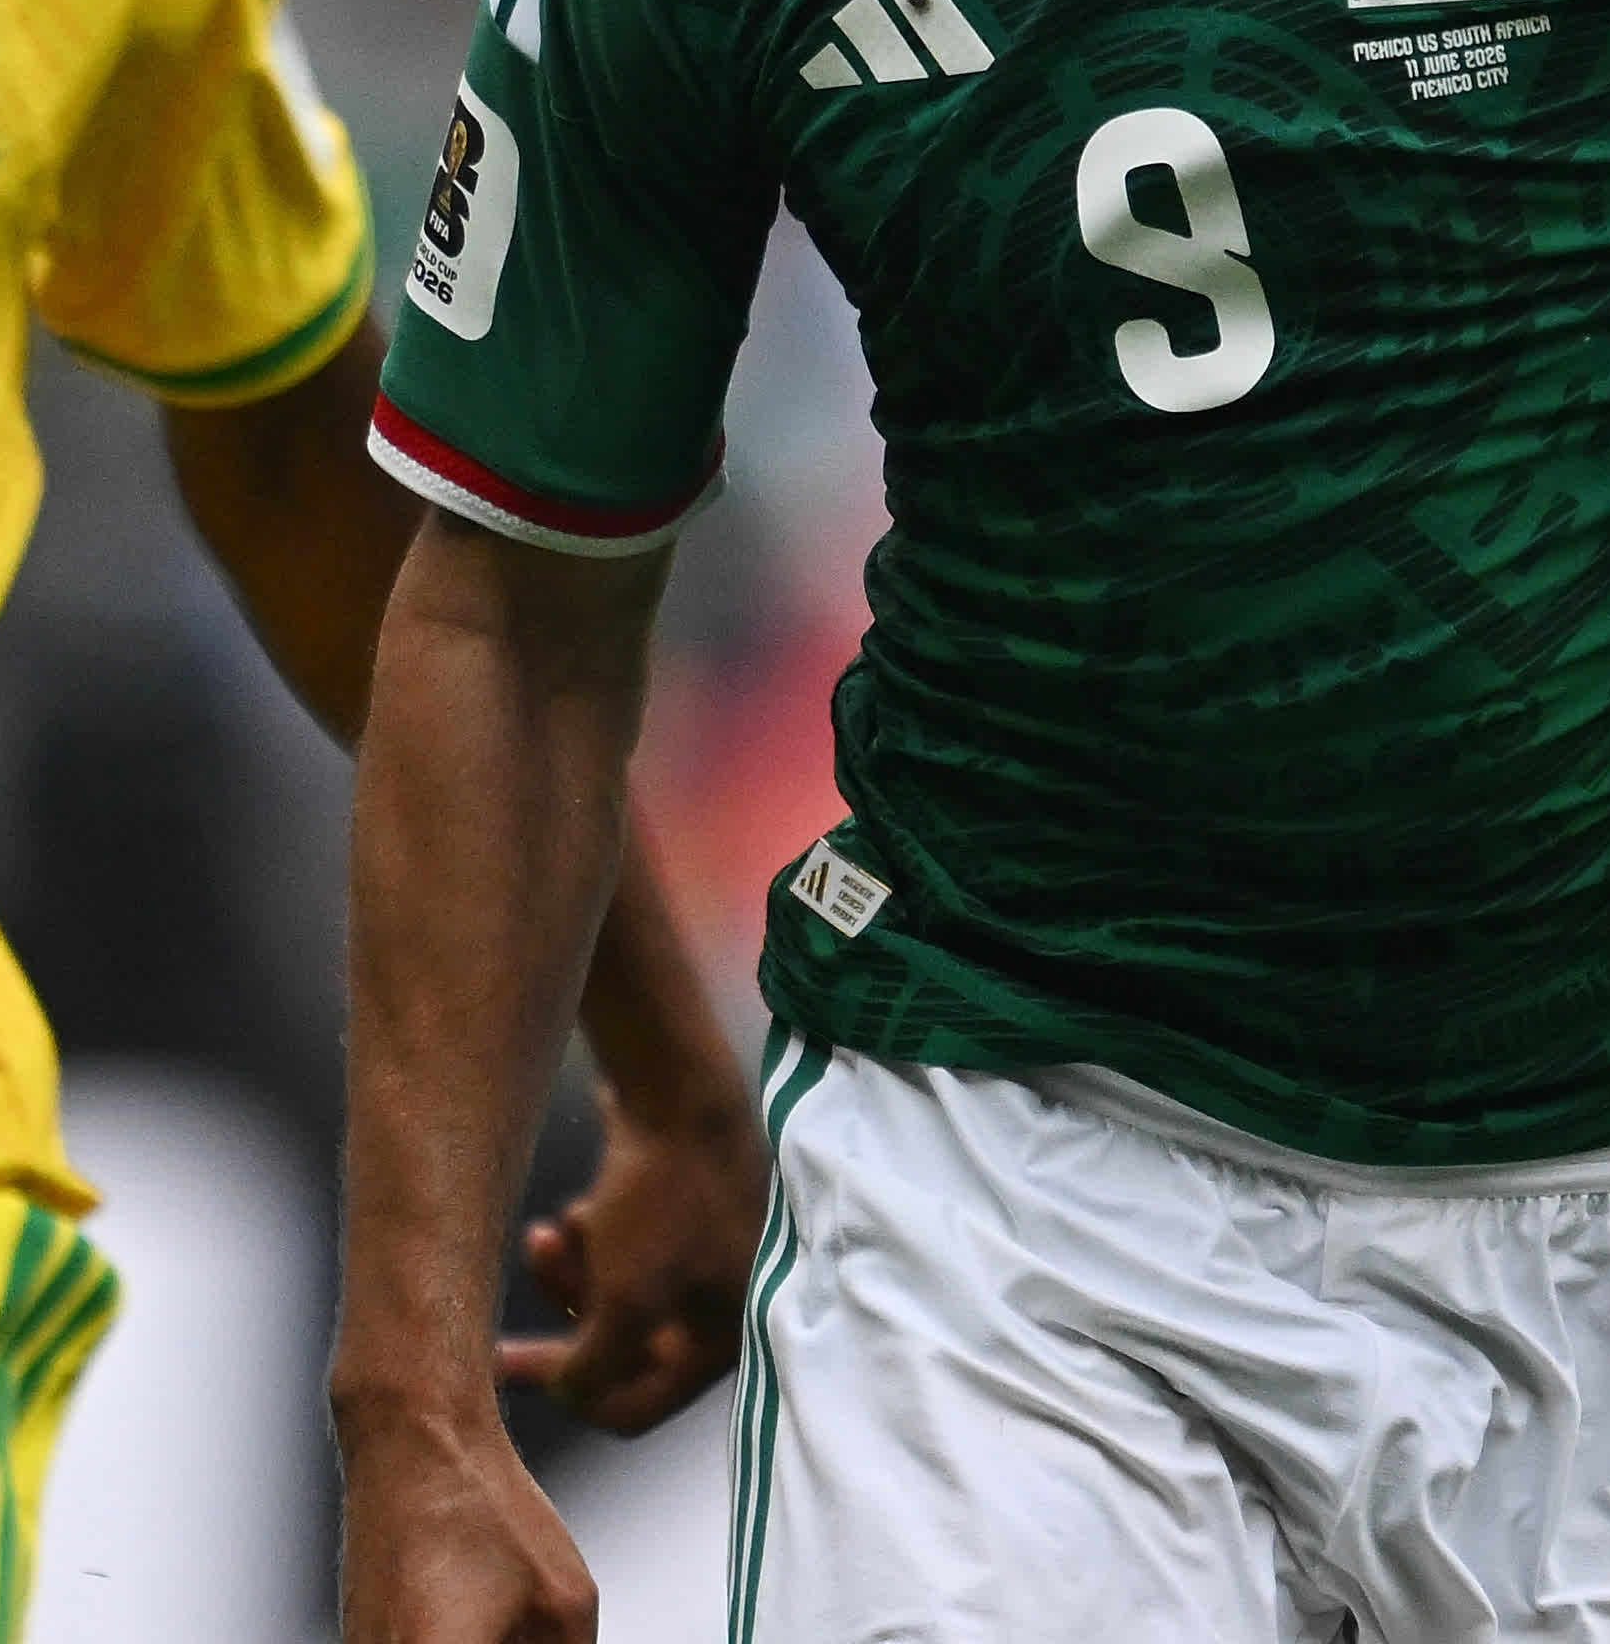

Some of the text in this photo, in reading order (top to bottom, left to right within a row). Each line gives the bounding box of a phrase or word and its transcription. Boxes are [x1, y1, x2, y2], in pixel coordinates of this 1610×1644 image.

[1352, 36, 1414, 63] MEXICO
[1442, 23, 1492, 50] SOUTH
[1495, 14, 1552, 40] AFRICA
[1404, 44, 1508, 78] 11 JUNE 2026
[1411, 66, 1510, 101] MEXICO CITY
[429, 209, 450, 243] FIFA
[437, 260, 459, 282] CUP
[1077, 108, 1275, 413] 9
[413, 258, 455, 306] 026
